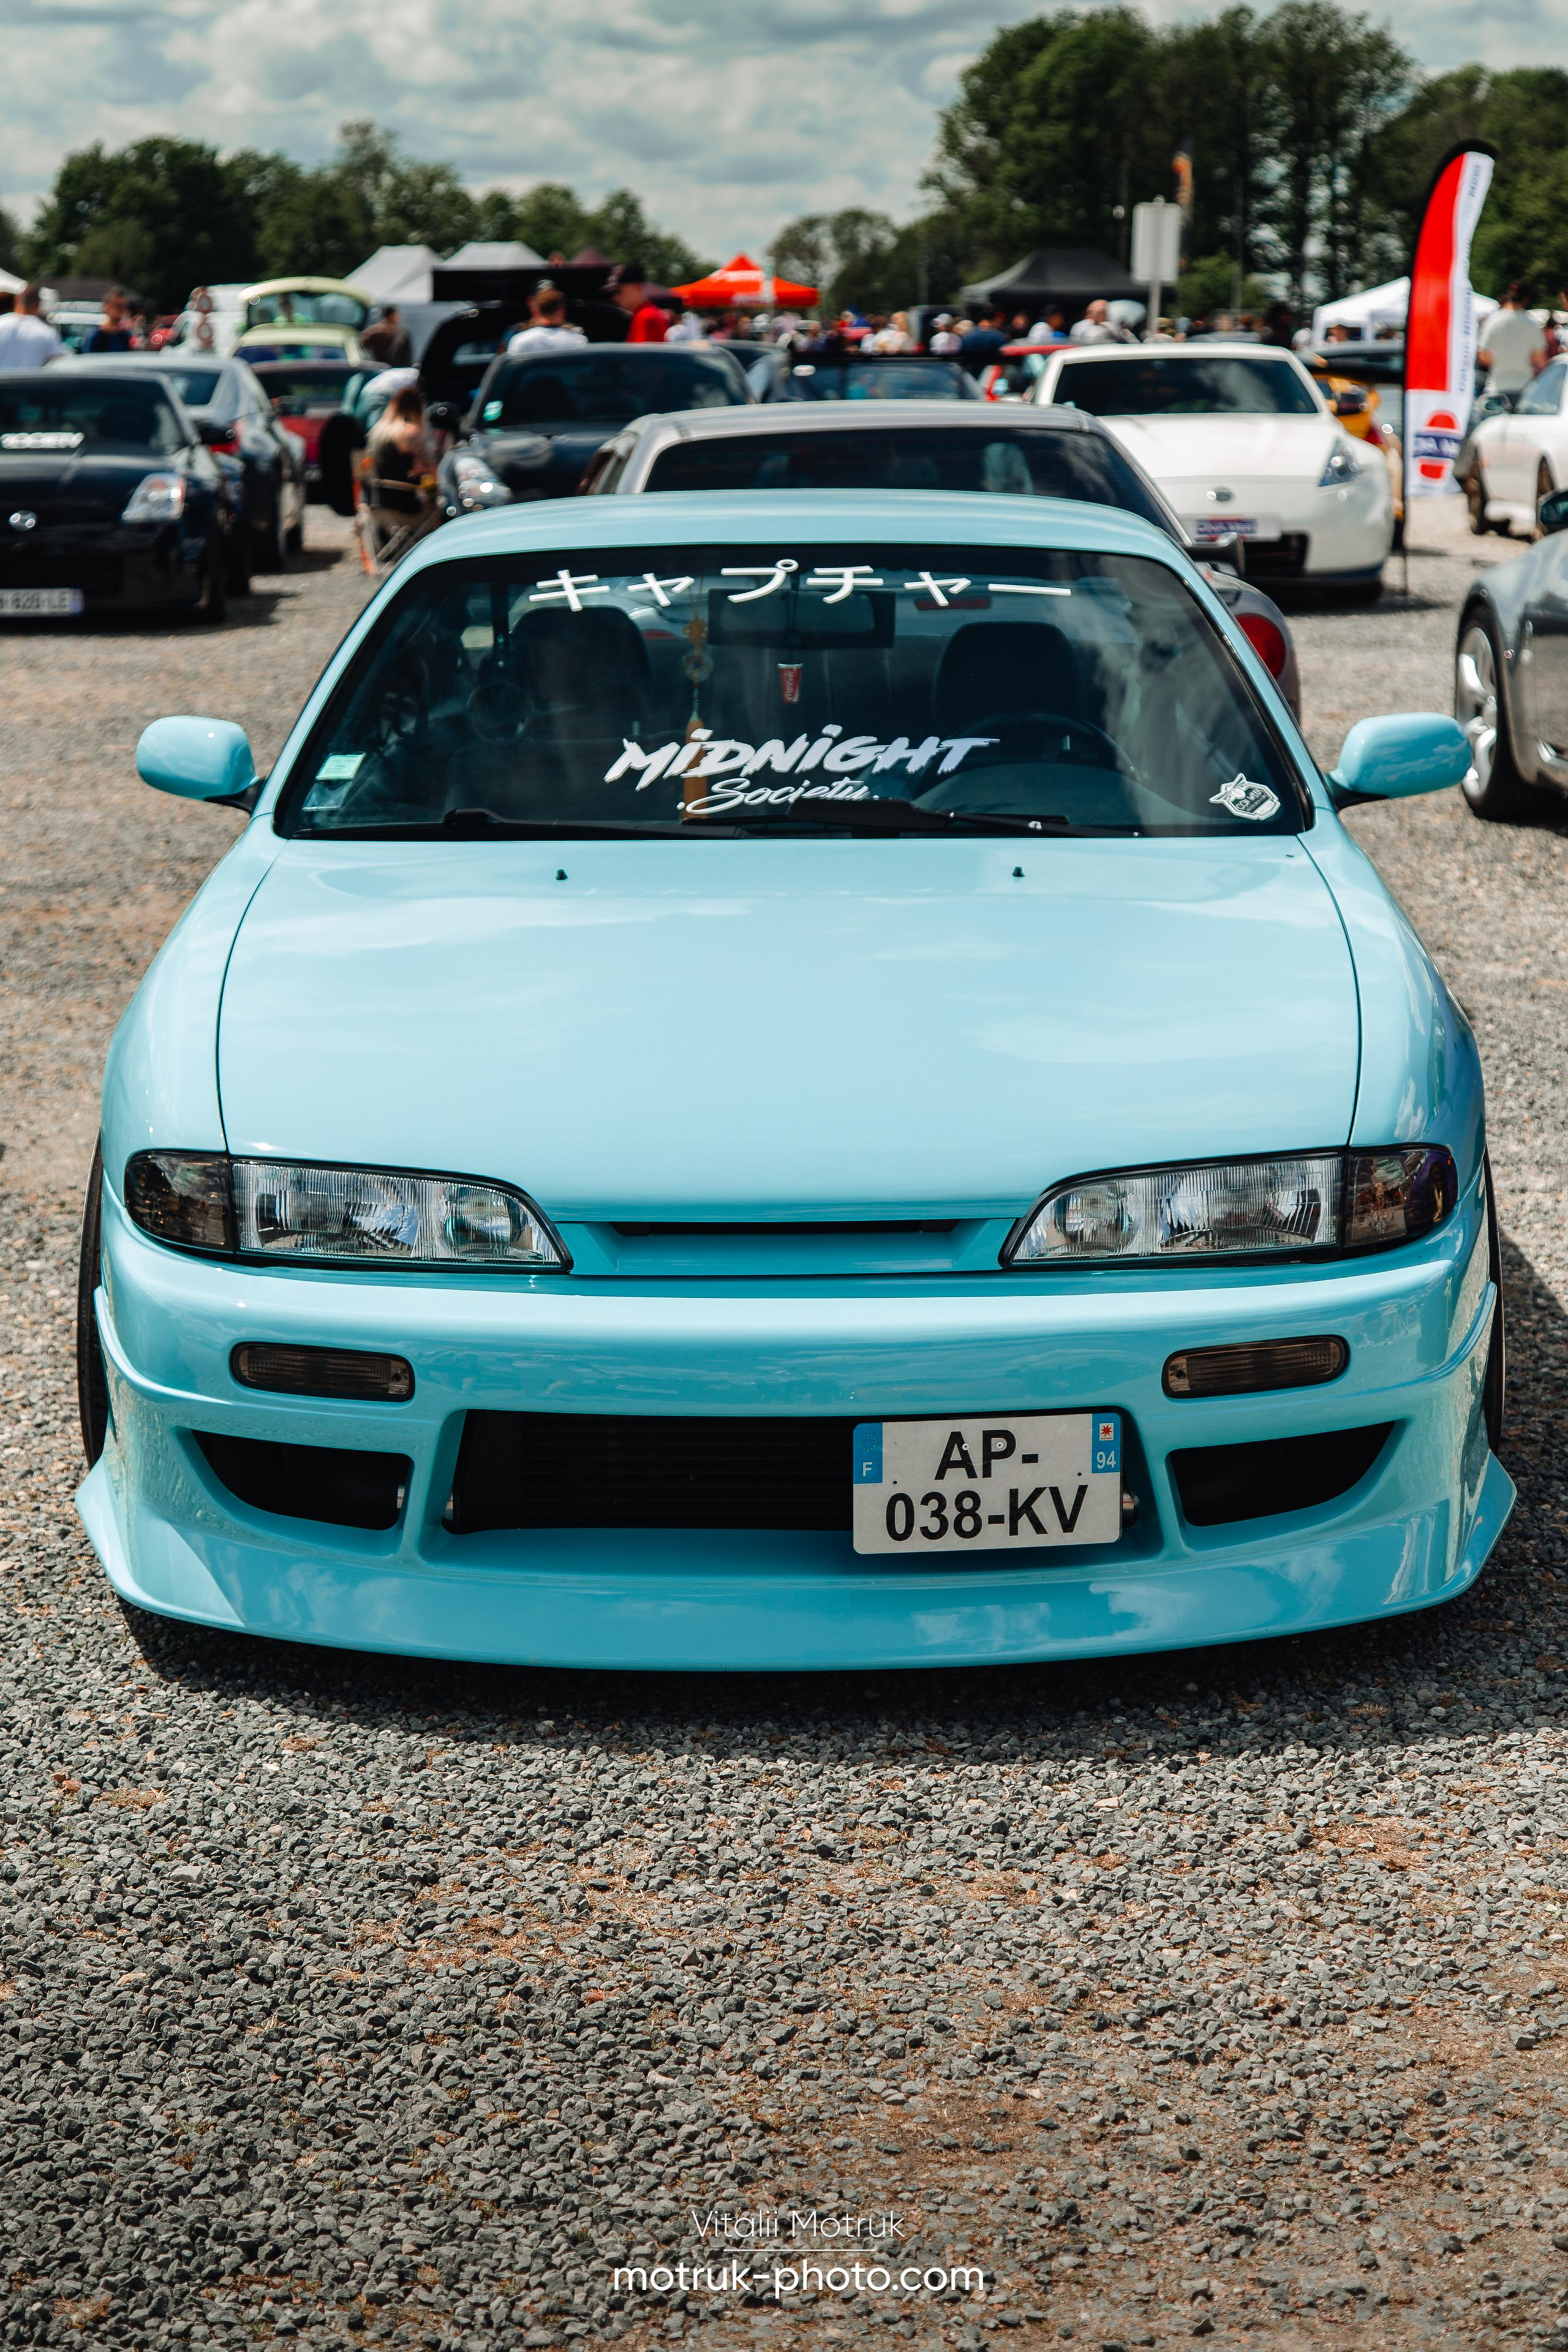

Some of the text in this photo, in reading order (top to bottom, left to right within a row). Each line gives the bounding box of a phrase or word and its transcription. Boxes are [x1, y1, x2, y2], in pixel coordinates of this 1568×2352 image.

[528, 558, 1072, 612] キャプチャー
[862, 1461, 873, 1477] F
[934, 1429, 1039, 1480] AP-
[1096, 1451, 1116, 1469] 94
[885, 1484, 1089, 1542] 038-KV
